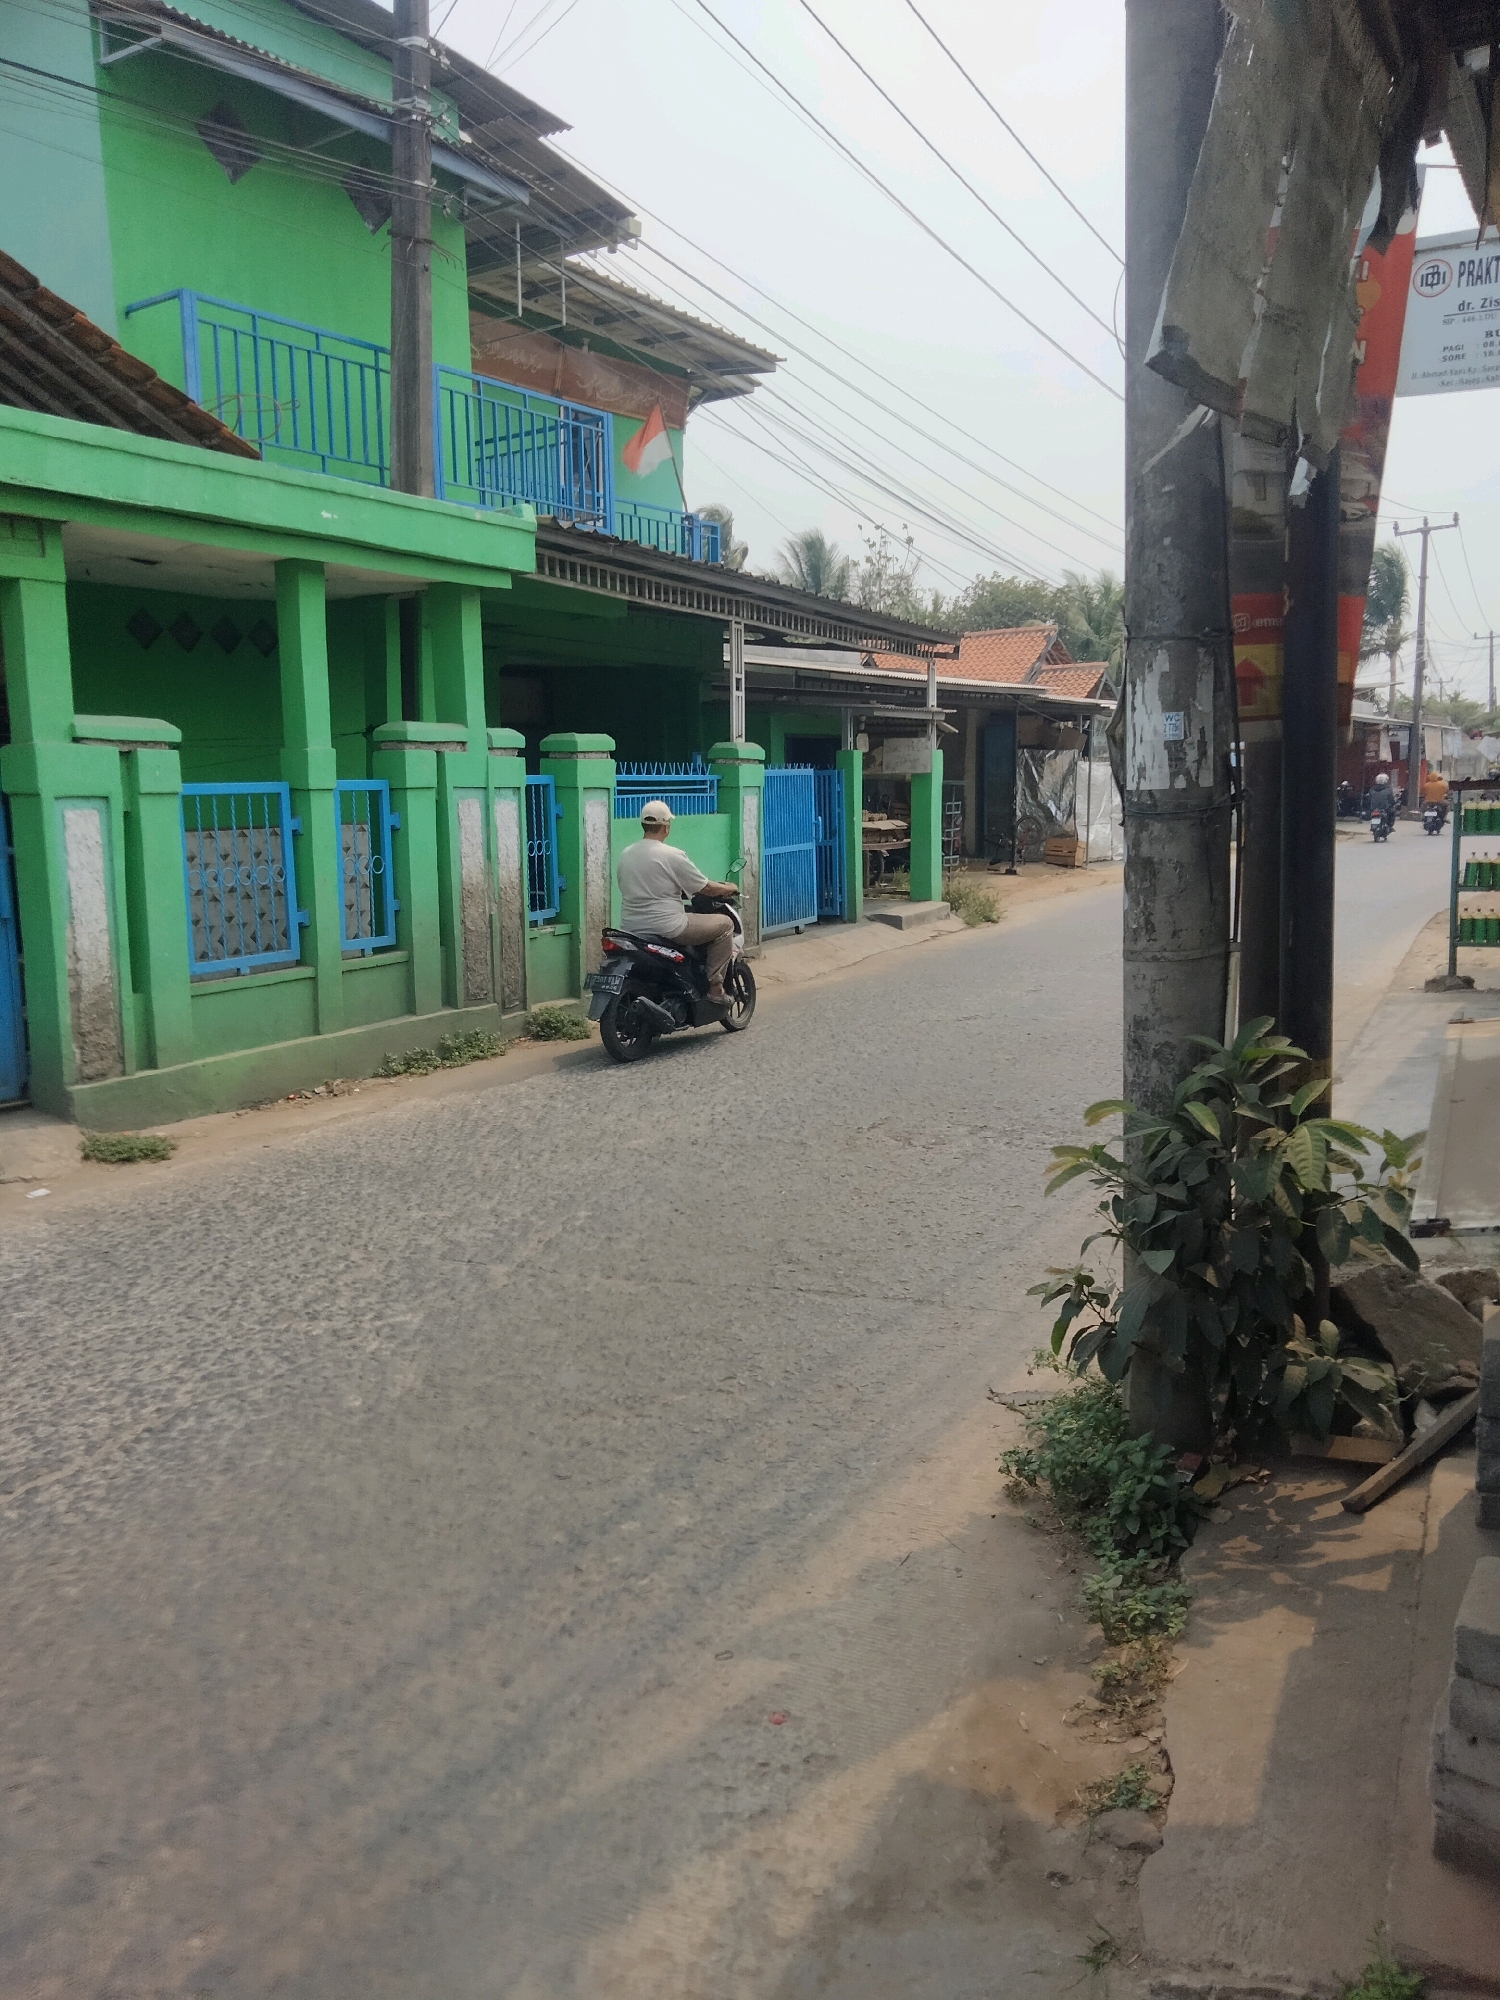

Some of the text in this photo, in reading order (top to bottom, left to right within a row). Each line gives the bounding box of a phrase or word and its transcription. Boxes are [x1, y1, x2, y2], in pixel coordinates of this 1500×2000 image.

[1457, 255, 1500, 288] PRAKT
[1458, 300, 1475, 311] dr.
[1442, 344, 1464, 352] PAGI
[1442, 353, 1466, 362] SORE
[1164, 713, 1181, 722] WC
